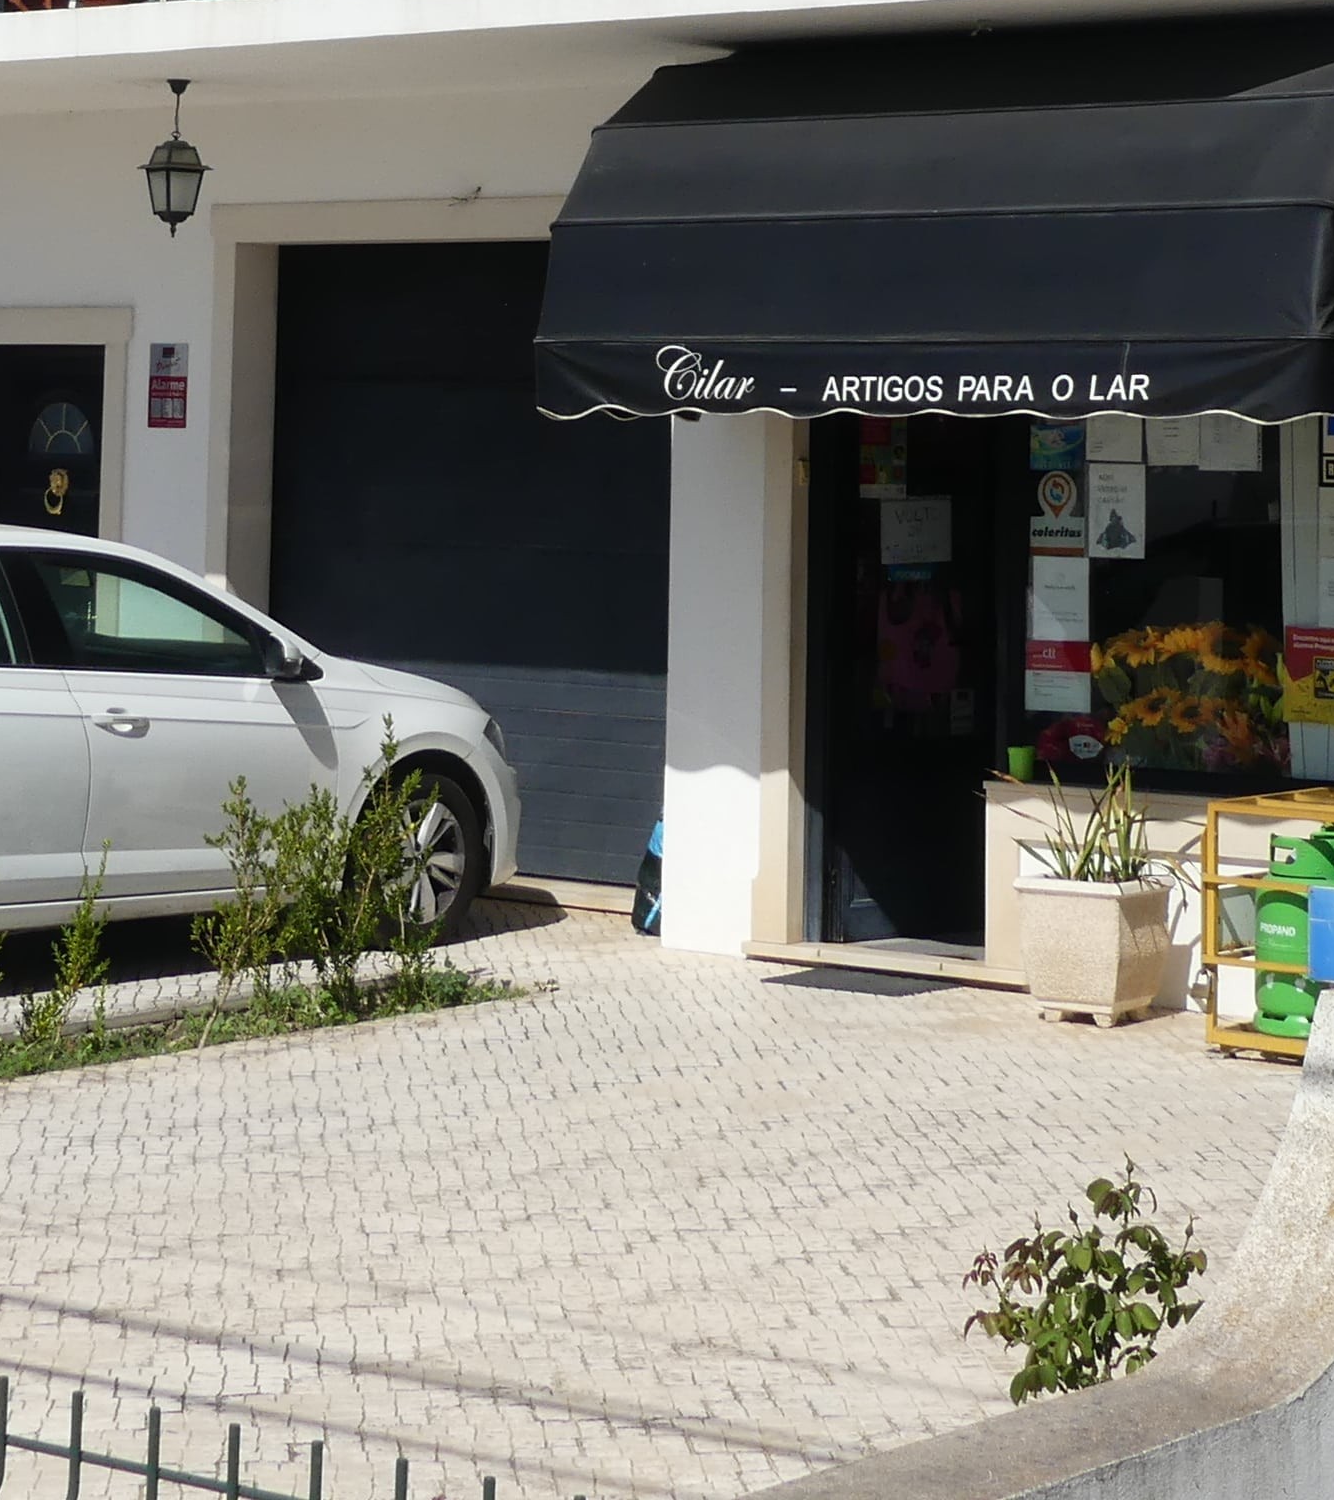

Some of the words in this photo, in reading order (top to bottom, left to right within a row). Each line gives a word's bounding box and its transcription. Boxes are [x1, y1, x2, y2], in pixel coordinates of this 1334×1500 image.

[656, 345, 755, 401] Cilar
[821, 375, 944, 403] ARTIGOS
[958, 374, 1035, 402] PARA
[1052, 374, 1075, 402] O
[1088, 373, 1150, 402] LAR
[151, 380, 186, 390] Alarme
[1259, 922, 1297, 937] PROPANO
